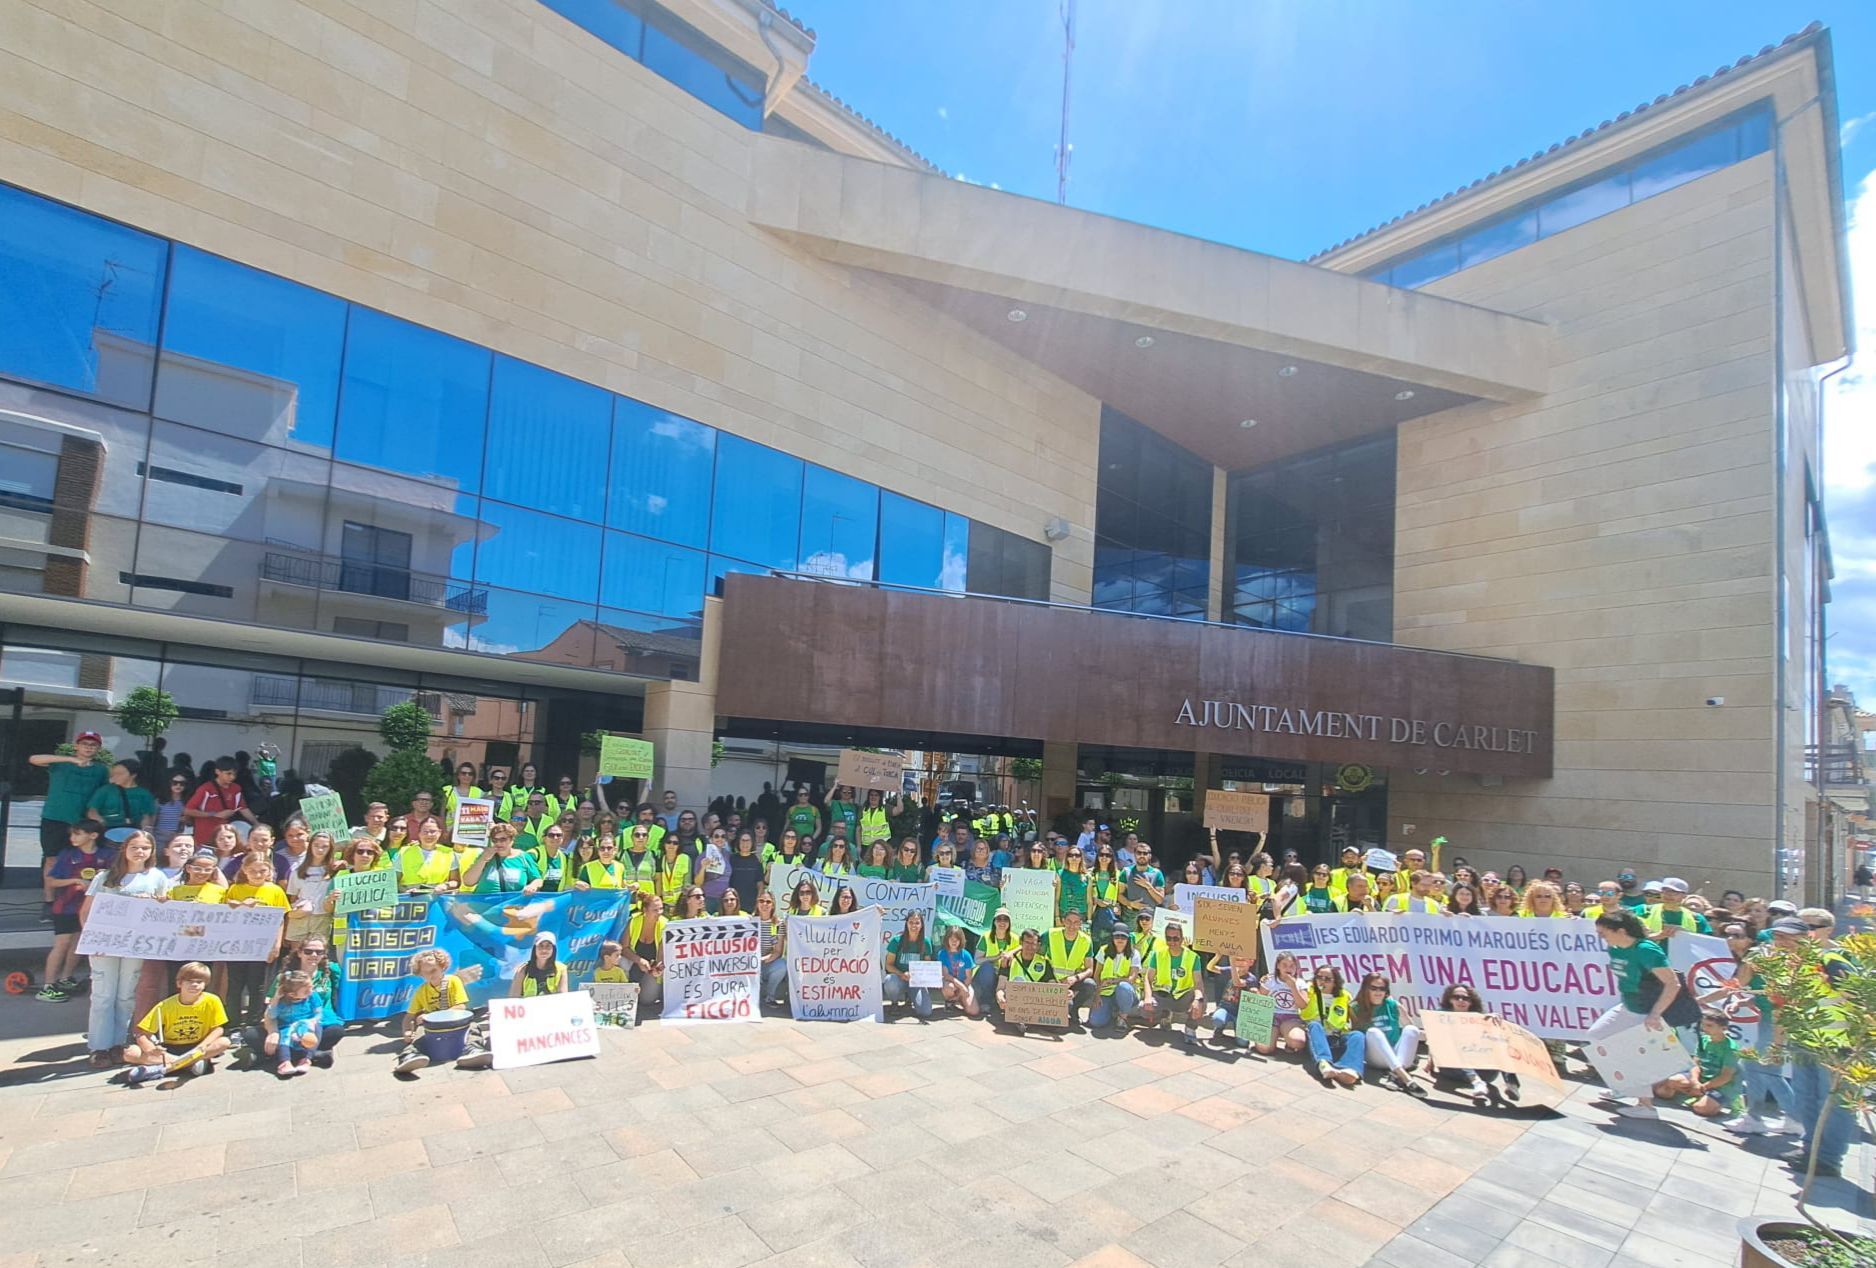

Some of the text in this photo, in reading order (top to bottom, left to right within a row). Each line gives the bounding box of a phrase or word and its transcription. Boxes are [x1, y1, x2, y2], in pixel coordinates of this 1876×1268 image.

[1174, 697, 1539, 755] AJUNTAMENT DE CARLET
[351, 929, 432, 947] BOSCH
[804, 923, 861, 947] lluitar
[1315, 927, 1340, 945] IES
[1343, 926, 1410, 946] EDUARDO
[1414, 927, 1463, 948] PRIMO
[1468, 928, 1550, 951] MARQUÉS
[823, 947, 843, 958] per
[1220, 942, 1243, 952] AULA
[669, 952, 759, 980] SENSE INVERSIÓ
[1296, 953, 1413, 984] EFENSEM
[1420, 954, 1476, 989] UNA
[1482, 958, 1617, 997] EDUCACI
[683, 980, 748, 999] ÉS PURA
[823, 973, 836, 985] és
[801, 985, 862, 1001] ESTIMAR
[504, 1004, 526, 1020] NO
[685, 994, 751, 1020] FICCIÓ
[1501, 1002, 1529, 1027] EN
[1037, 1016, 1062, 1026] AIGUA
[516, 1028, 592, 1055] MANCANCES
